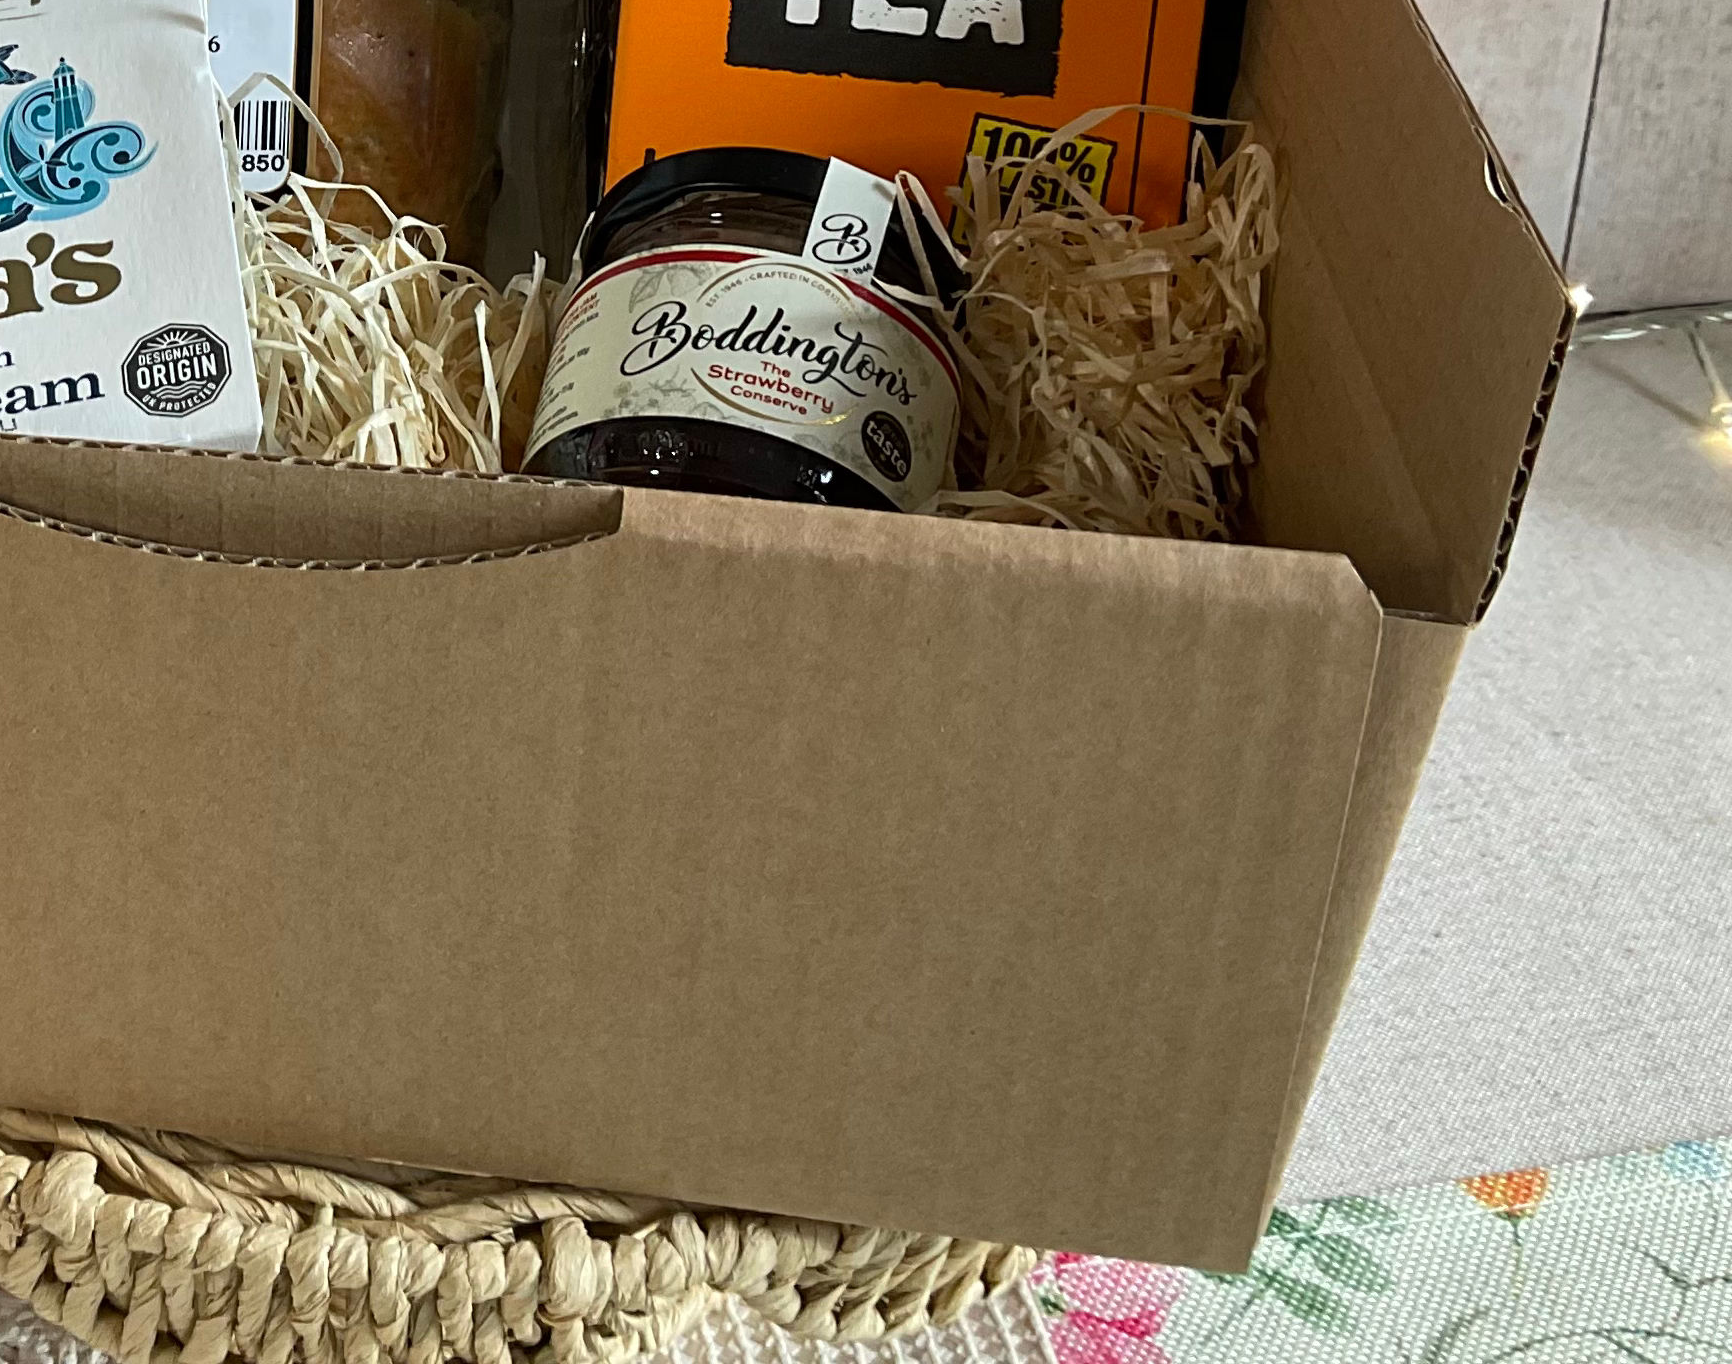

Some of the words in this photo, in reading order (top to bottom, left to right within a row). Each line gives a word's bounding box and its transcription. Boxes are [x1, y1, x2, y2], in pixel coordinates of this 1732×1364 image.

[240, 154, 286, 173] 850
[749, 270, 798, 282] CRAFTED
[137, 341, 212, 367] DESIGNATED
[619, 300, 918, 406] Boddington's
[136, 352, 218, 390] ORIGIN
[759, 360, 793, 379] The
[158, 381, 218, 411] PROTECTED
[707, 363, 835, 414] Strawberry
[729, 385, 809, 416] Conserve
[866, 420, 907, 476] taste
